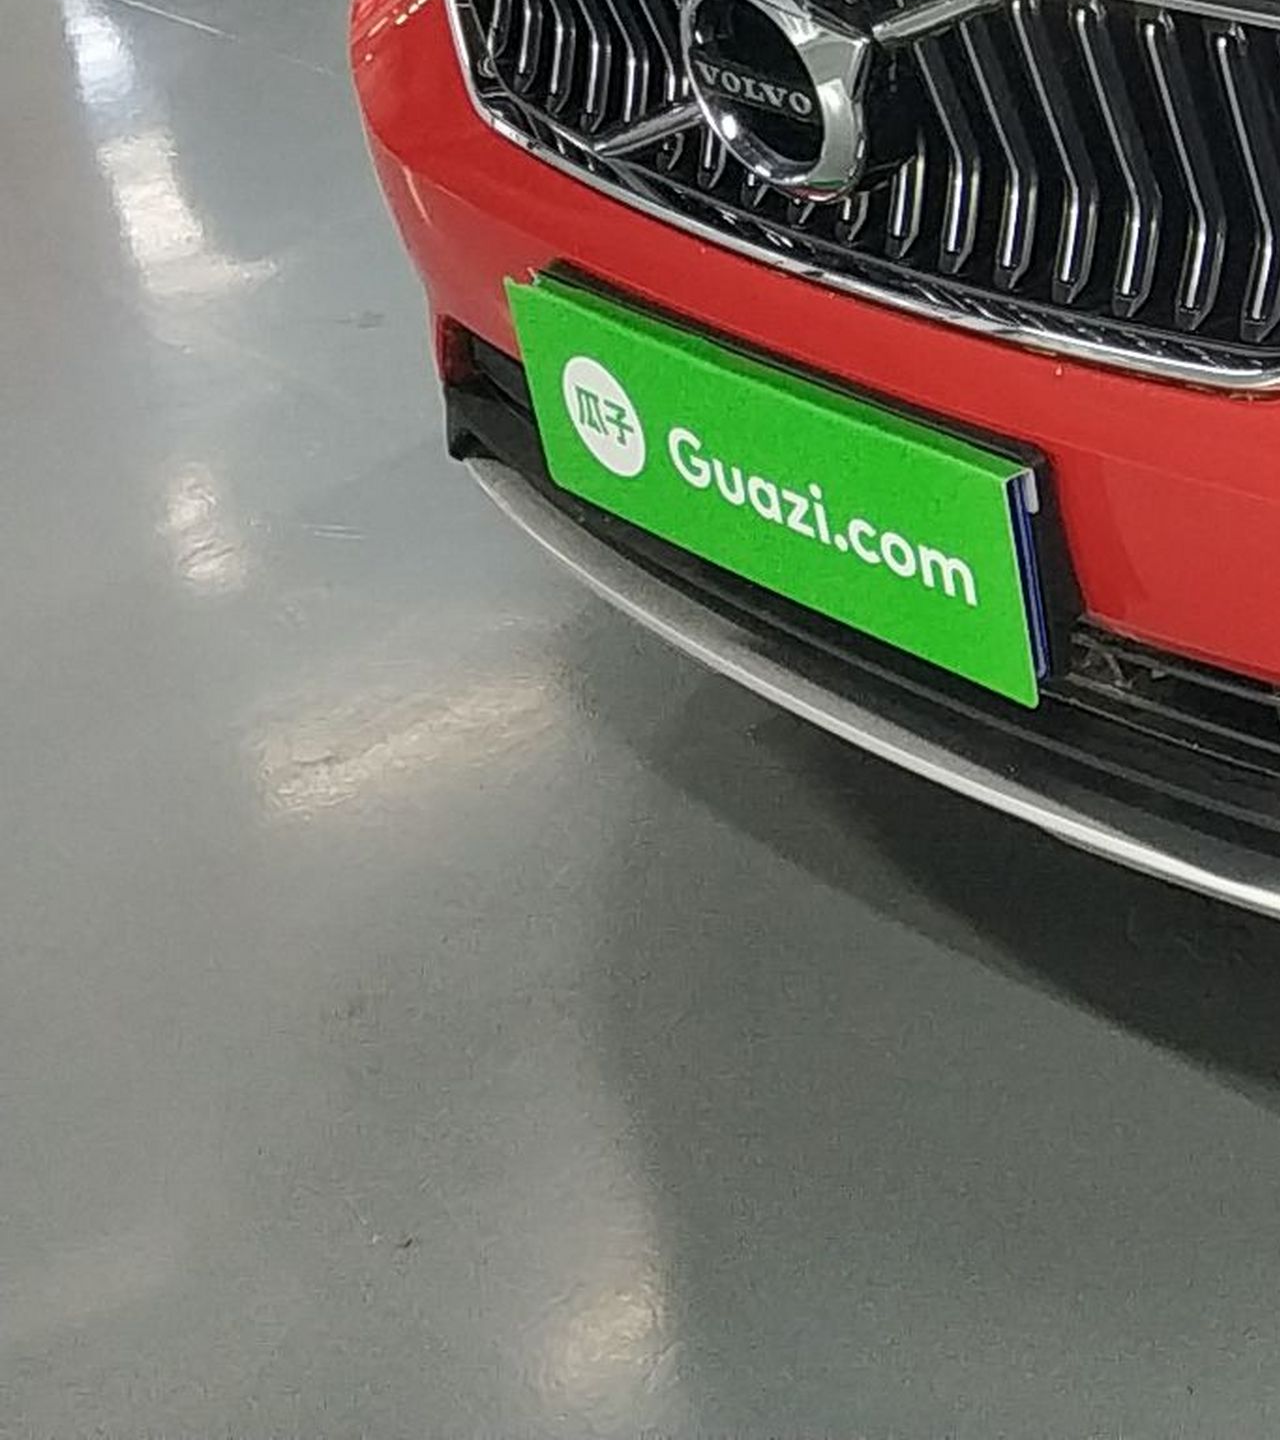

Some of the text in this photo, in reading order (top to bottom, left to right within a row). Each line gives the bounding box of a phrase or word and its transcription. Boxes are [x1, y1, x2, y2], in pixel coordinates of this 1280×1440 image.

[696, 61, 812, 115] VOLVO
[574, 384, 635, 446] 瓜子
[668, 427, 978, 606] Guazi.com
